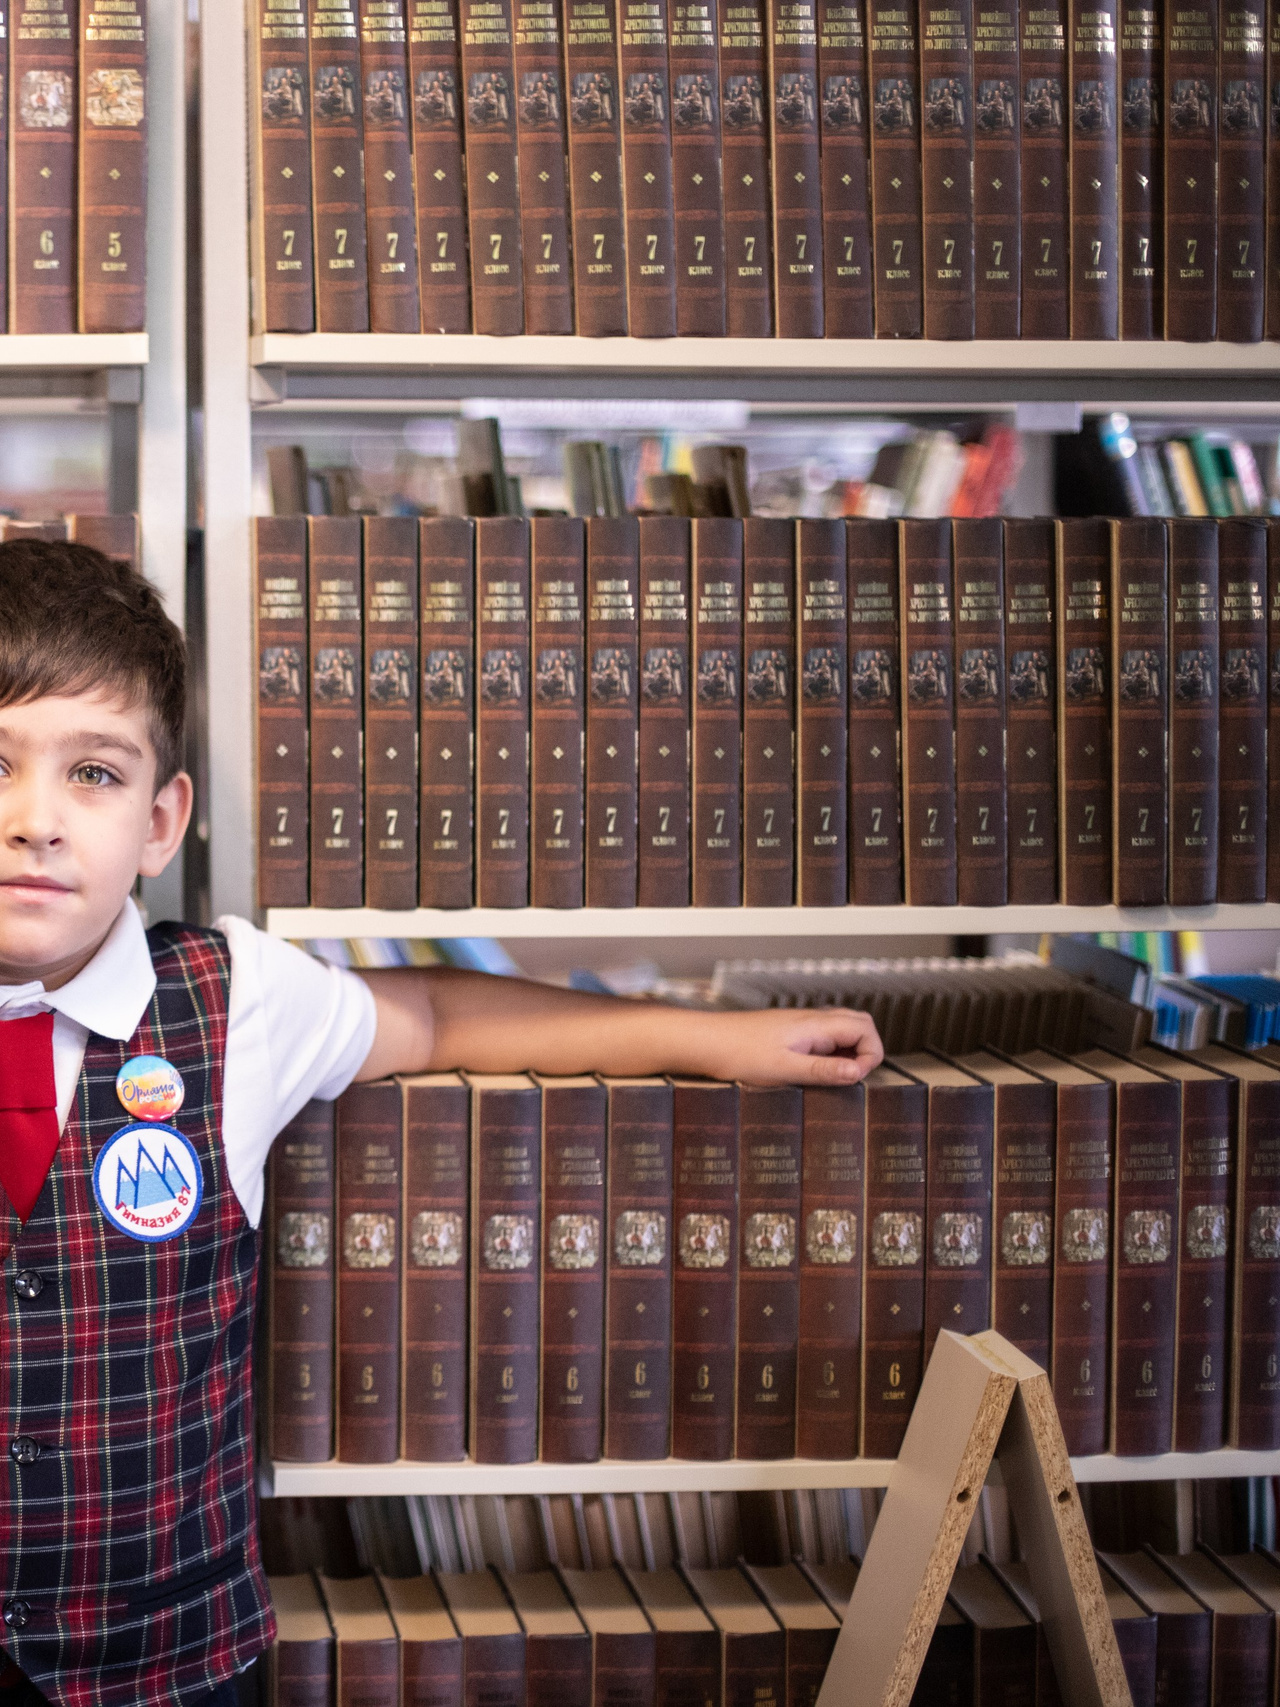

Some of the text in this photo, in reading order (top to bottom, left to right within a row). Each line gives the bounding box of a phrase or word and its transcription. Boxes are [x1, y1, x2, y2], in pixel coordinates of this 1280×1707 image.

[39, 230, 54, 255] 6
[108, 232, 122, 257] 5
[282, 229, 295, 256] 7
[335, 228, 348, 255] 7
[386, 232, 399, 259] 7
[436, 231, 448, 258] 7
[489, 233, 502, 260] 7
[541, 233, 553, 259] 7
[593, 233, 605, 260] 7
[646, 234, 658, 261] 7
[694, 235, 706, 261] 7
[744, 236, 756, 262] 7
[796, 234, 807, 259] 7
[843, 236, 854, 261] 7
[892, 239, 904, 265] 7
[943, 239, 955, 265] 7
[992, 240, 1003, 266] 7
[1040, 238, 1052, 263] 7
[1091, 240, 1102, 264] 7
[1139, 237, 1150, 263] 7
[1186, 239, 1198, 264] 7
[1238, 240, 1250, 265] 7
[276, 806, 289, 833] 7
[331, 807, 344, 835] 7
[386, 809, 398, 836] 7
[440, 809, 453, 836] 7
[498, 809, 510, 835] 7
[553, 808, 564, 835] 7
[606, 806, 617, 833] 7
[658, 806, 671, 832] 7
[714, 808, 726, 834] 7
[763, 808, 775, 834] 7
[820, 806, 832, 831] 7
[871, 807, 883, 833] 7
[927, 807, 938, 832] 7
[978, 806, 990, 831] 7
[1026, 808, 1038, 833] 7
[1084, 805, 1096, 830] 7
[1138, 807, 1149, 833] 7
[1191, 807, 1202, 832] 7
[1238, 805, 1248, 830] 7
[122, 1079, 174, 1102] Орлята
[115, 1185, 191, 1228] Гимназия 87
[501, 1366, 514, 1389] 6
[566, 1366, 579, 1391] 6
[634, 1362, 646, 1385] 6
[698, 1364, 710, 1389] 6
[761, 1365, 774, 1389] 6
[888, 1363, 901, 1387] 6
[1080, 1359, 1091, 1382] 6
[1141, 1360, 1153, 1384] 6
[1201, 1354, 1212, 1379] 6
[1267, 1354, 1278, 1377] 6
